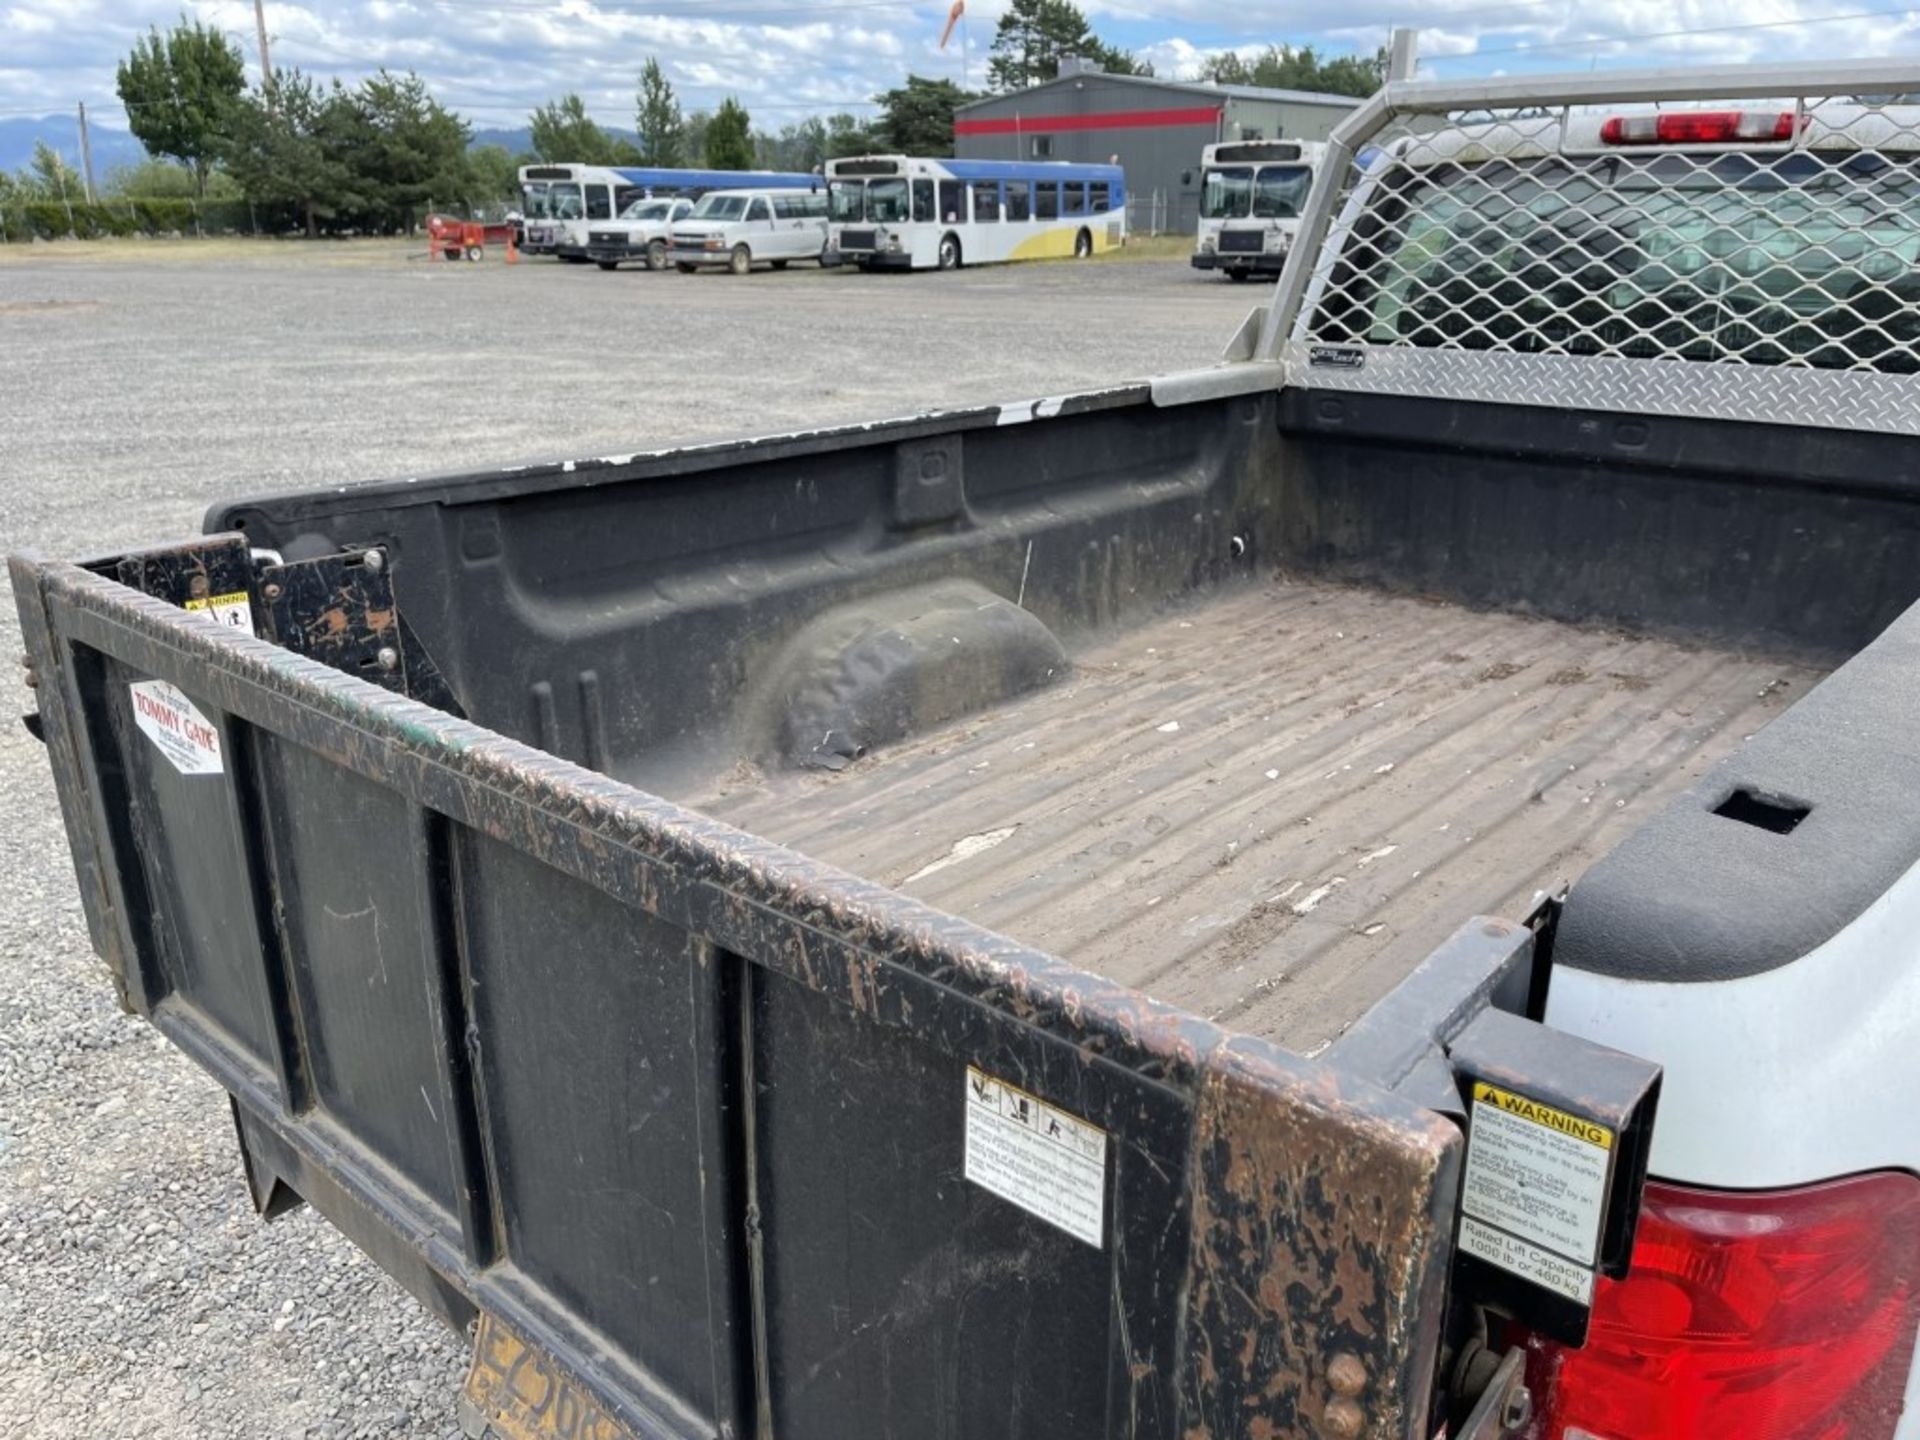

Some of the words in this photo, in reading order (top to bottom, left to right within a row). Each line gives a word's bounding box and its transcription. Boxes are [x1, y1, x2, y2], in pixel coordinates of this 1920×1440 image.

[134, 691, 179, 732] TOMMY
[184, 719, 216, 753] GATE
[1504, 1095, 1603, 1143] WARNING
[1465, 1222, 1502, 1246] Rated
[1506, 1239, 1525, 1256] Lift
[1529, 1250, 1587, 1286] Capacity
[1470, 1238, 1498, 1258] 1000
[1503, 1252, 1514, 1265] lb
[1518, 1259, 1533, 1273] or
[1563, 1279, 1580, 1296] kg
